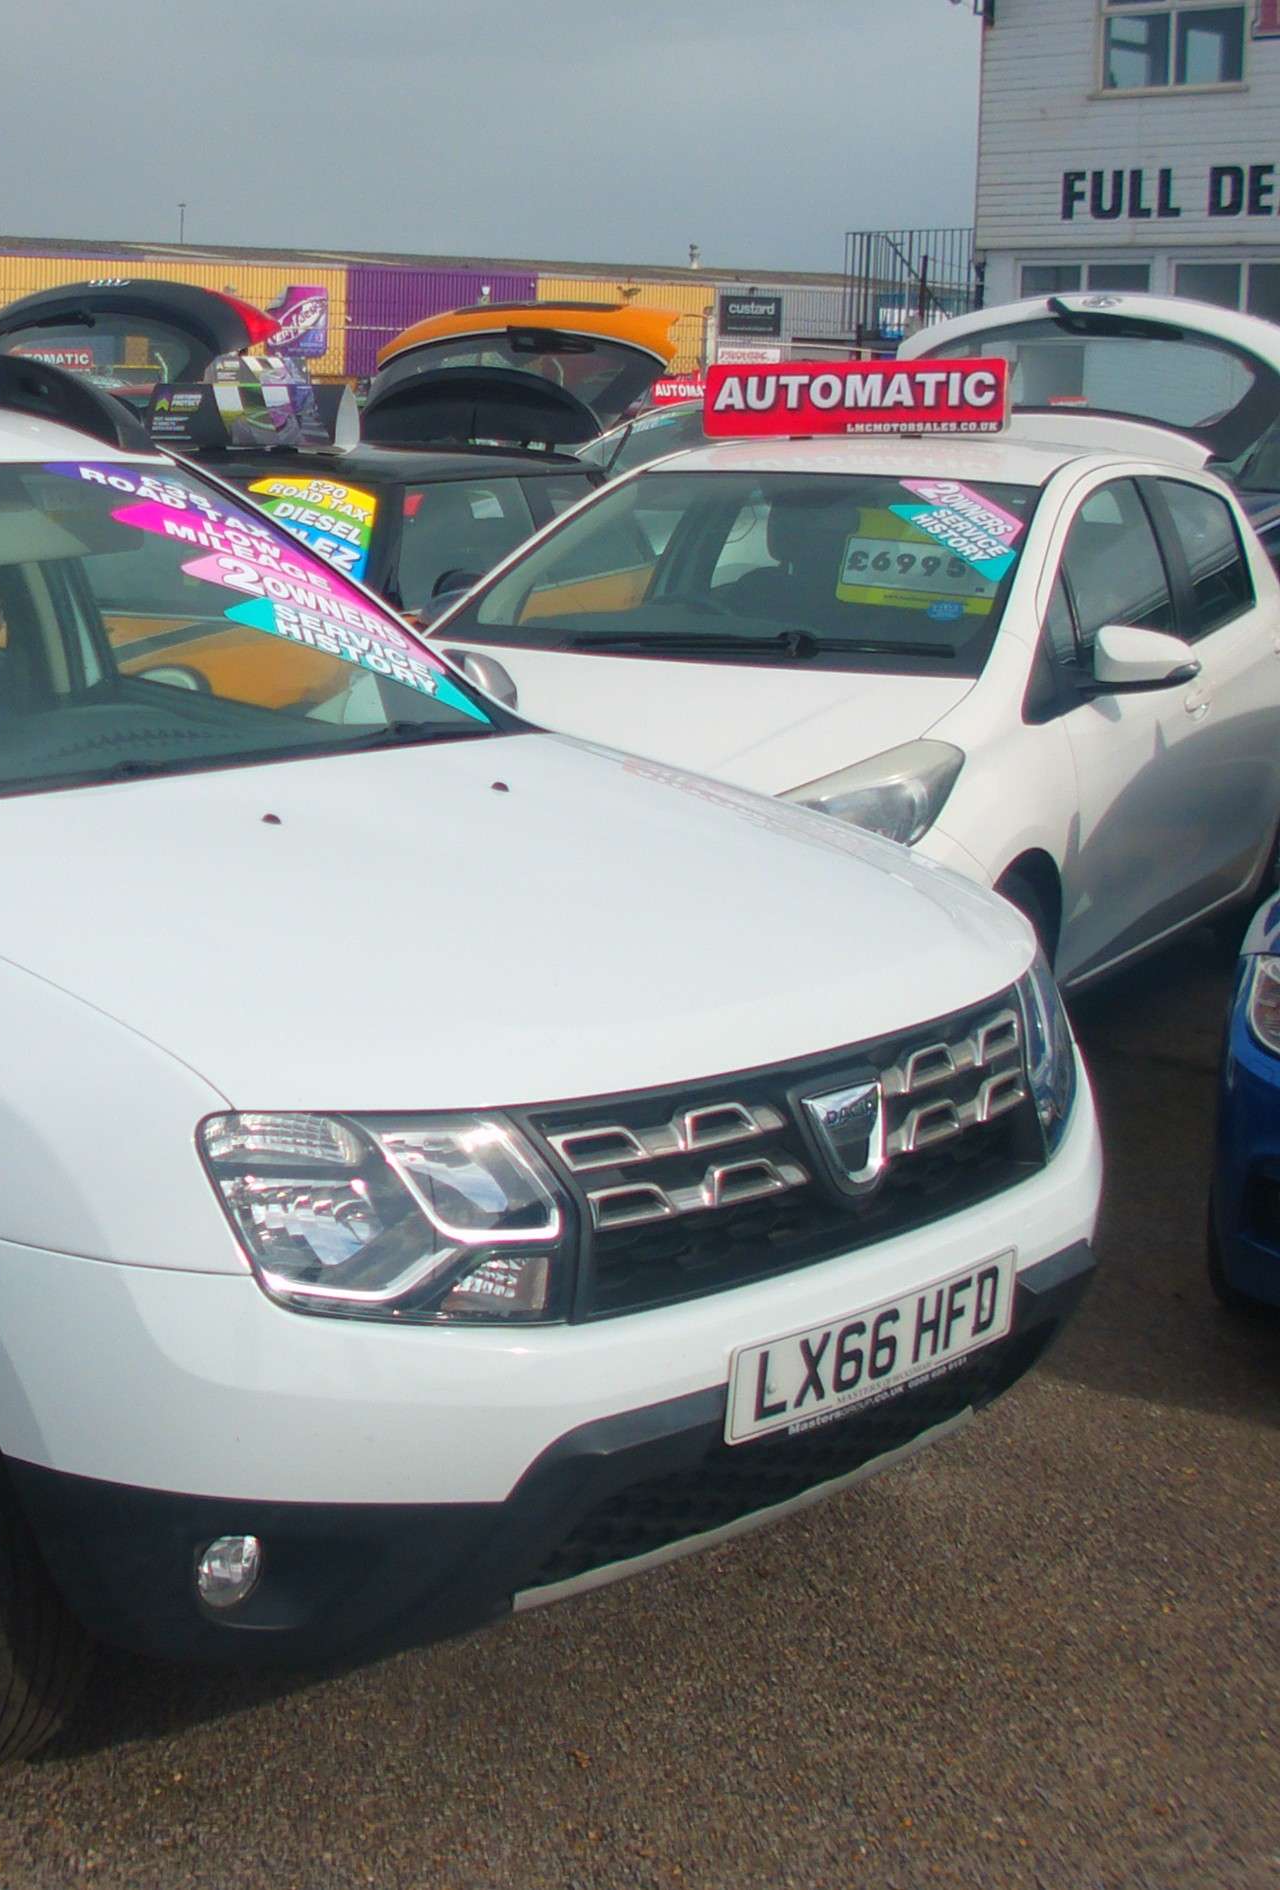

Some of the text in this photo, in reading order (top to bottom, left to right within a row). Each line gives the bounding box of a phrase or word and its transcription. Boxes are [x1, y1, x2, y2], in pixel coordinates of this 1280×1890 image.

[1061, 164, 1280, 220] FULL DE
[728, 302, 775, 316] custard
[655, 383, 706, 398] AUTOMA
[713, 372, 997, 412] AUTOMATIC
[846, 421, 999, 433] LMCMOTORSALES.CO.UK
[79, 467, 275, 544] ROAD TAX
[268, 483, 372, 523] ROAD TAX
[309, 480, 347, 498] £20
[272, 503, 361, 545] DIESEL
[933, 508, 1009, 557] SERVICE
[941, 493, 1012, 536] OWNERS
[163, 520, 331, 592] MILEAGE
[202, 520, 281, 559] LOW
[912, 513, 992, 562] HISTORY
[847, 550, 966, 578] £6995
[217, 557, 408, 648] 2 OWNERS
[273, 603, 431, 679] SERVICE
[276, 619, 436, 695] HISTORY
[754, 1265, 999, 1422] LX66 HFD
